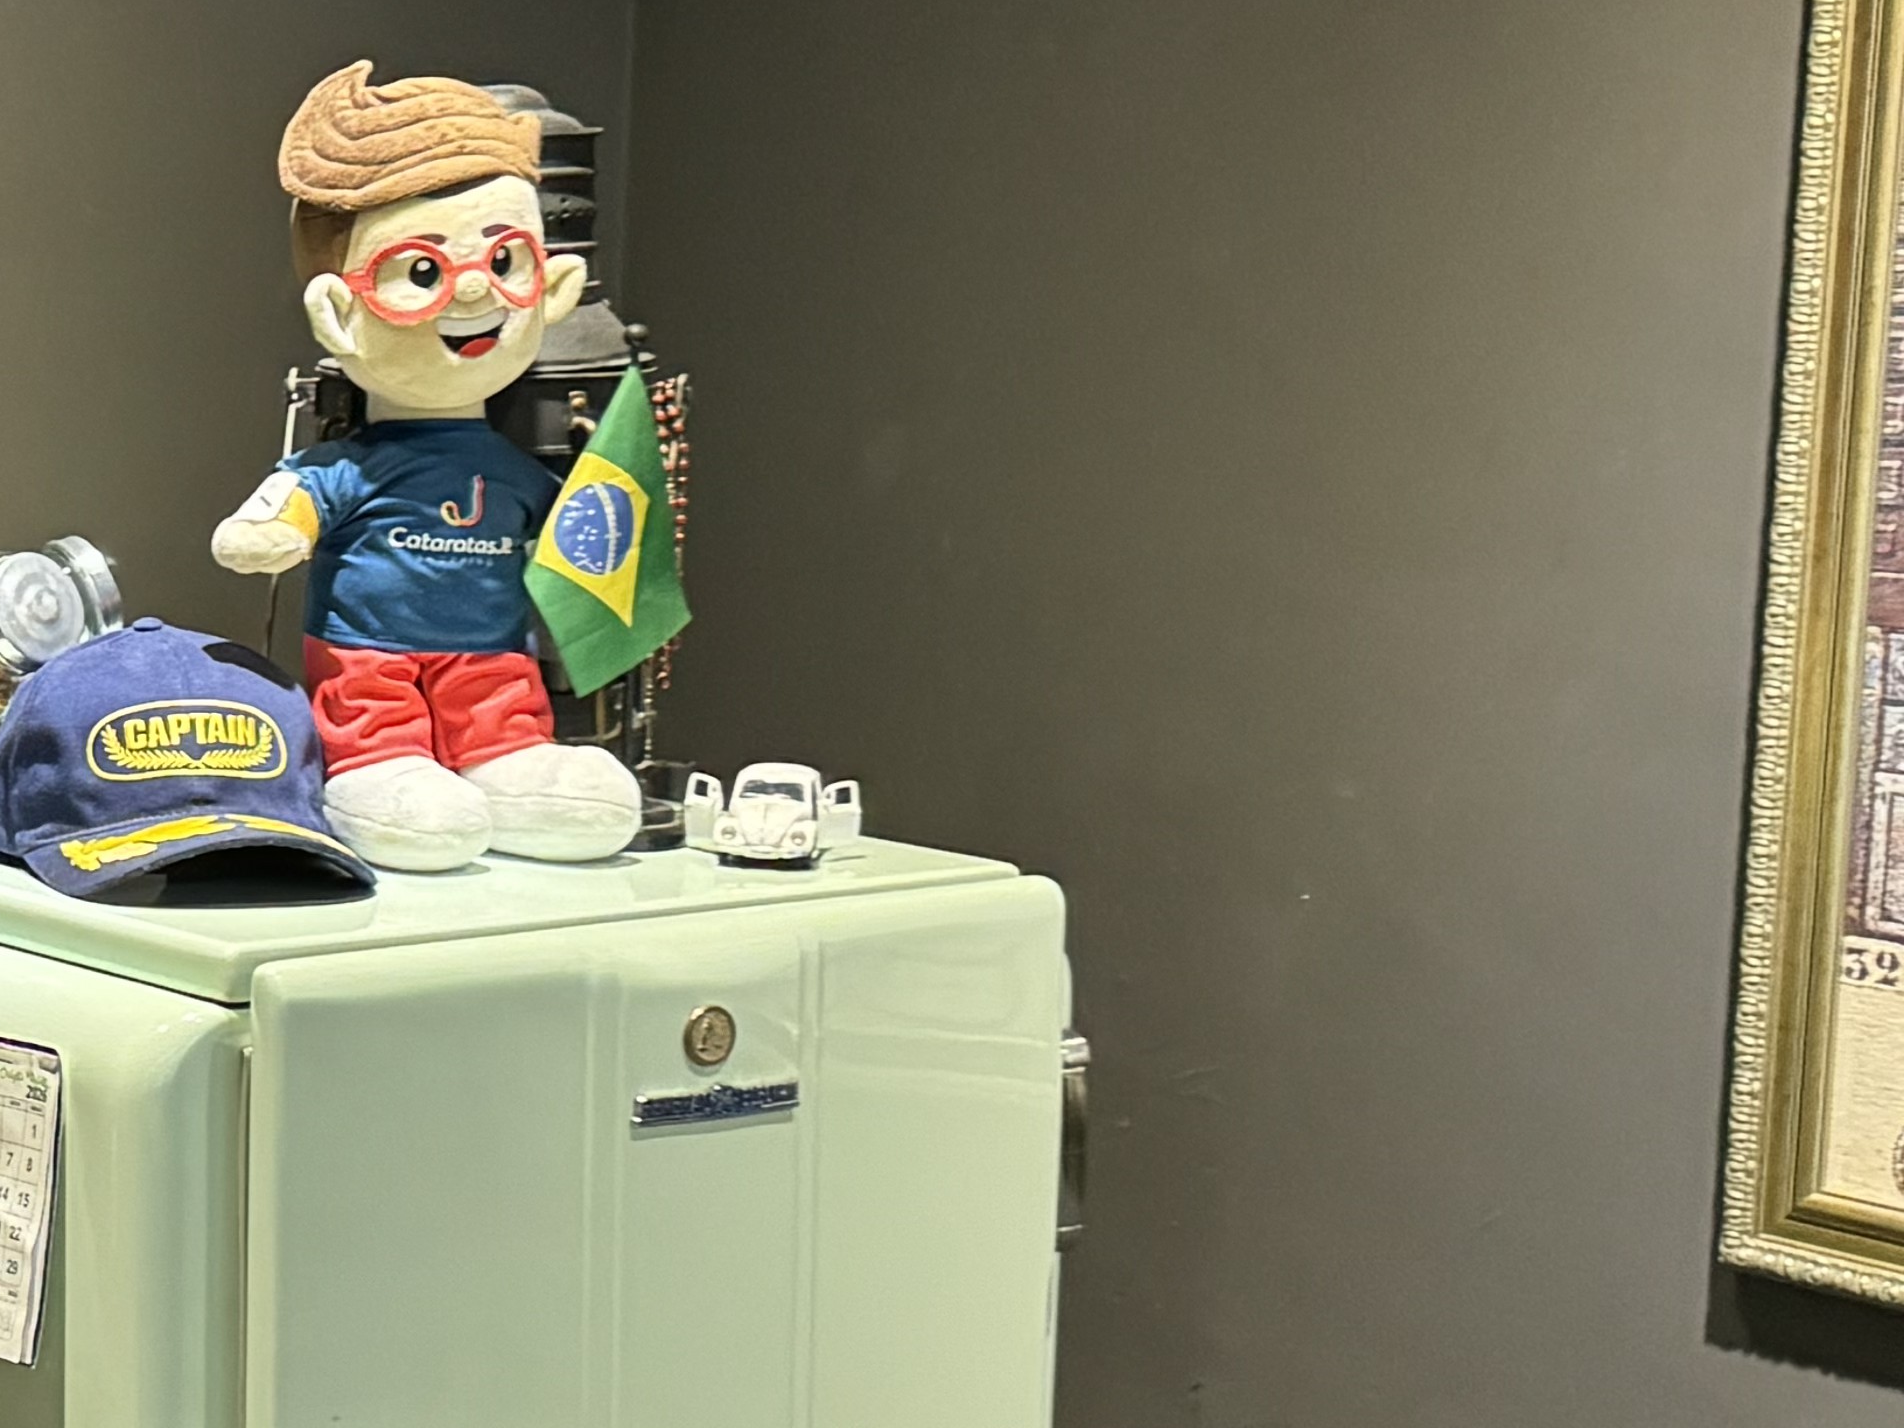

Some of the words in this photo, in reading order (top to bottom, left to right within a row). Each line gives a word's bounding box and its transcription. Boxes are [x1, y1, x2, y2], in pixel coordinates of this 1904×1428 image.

[388, 526, 496, 555] Cataratas
[122, 712, 257, 750] CAPTAIN
[6, 1151, 14, 1167] 7
[9, 1225, 22, 1242] 22
